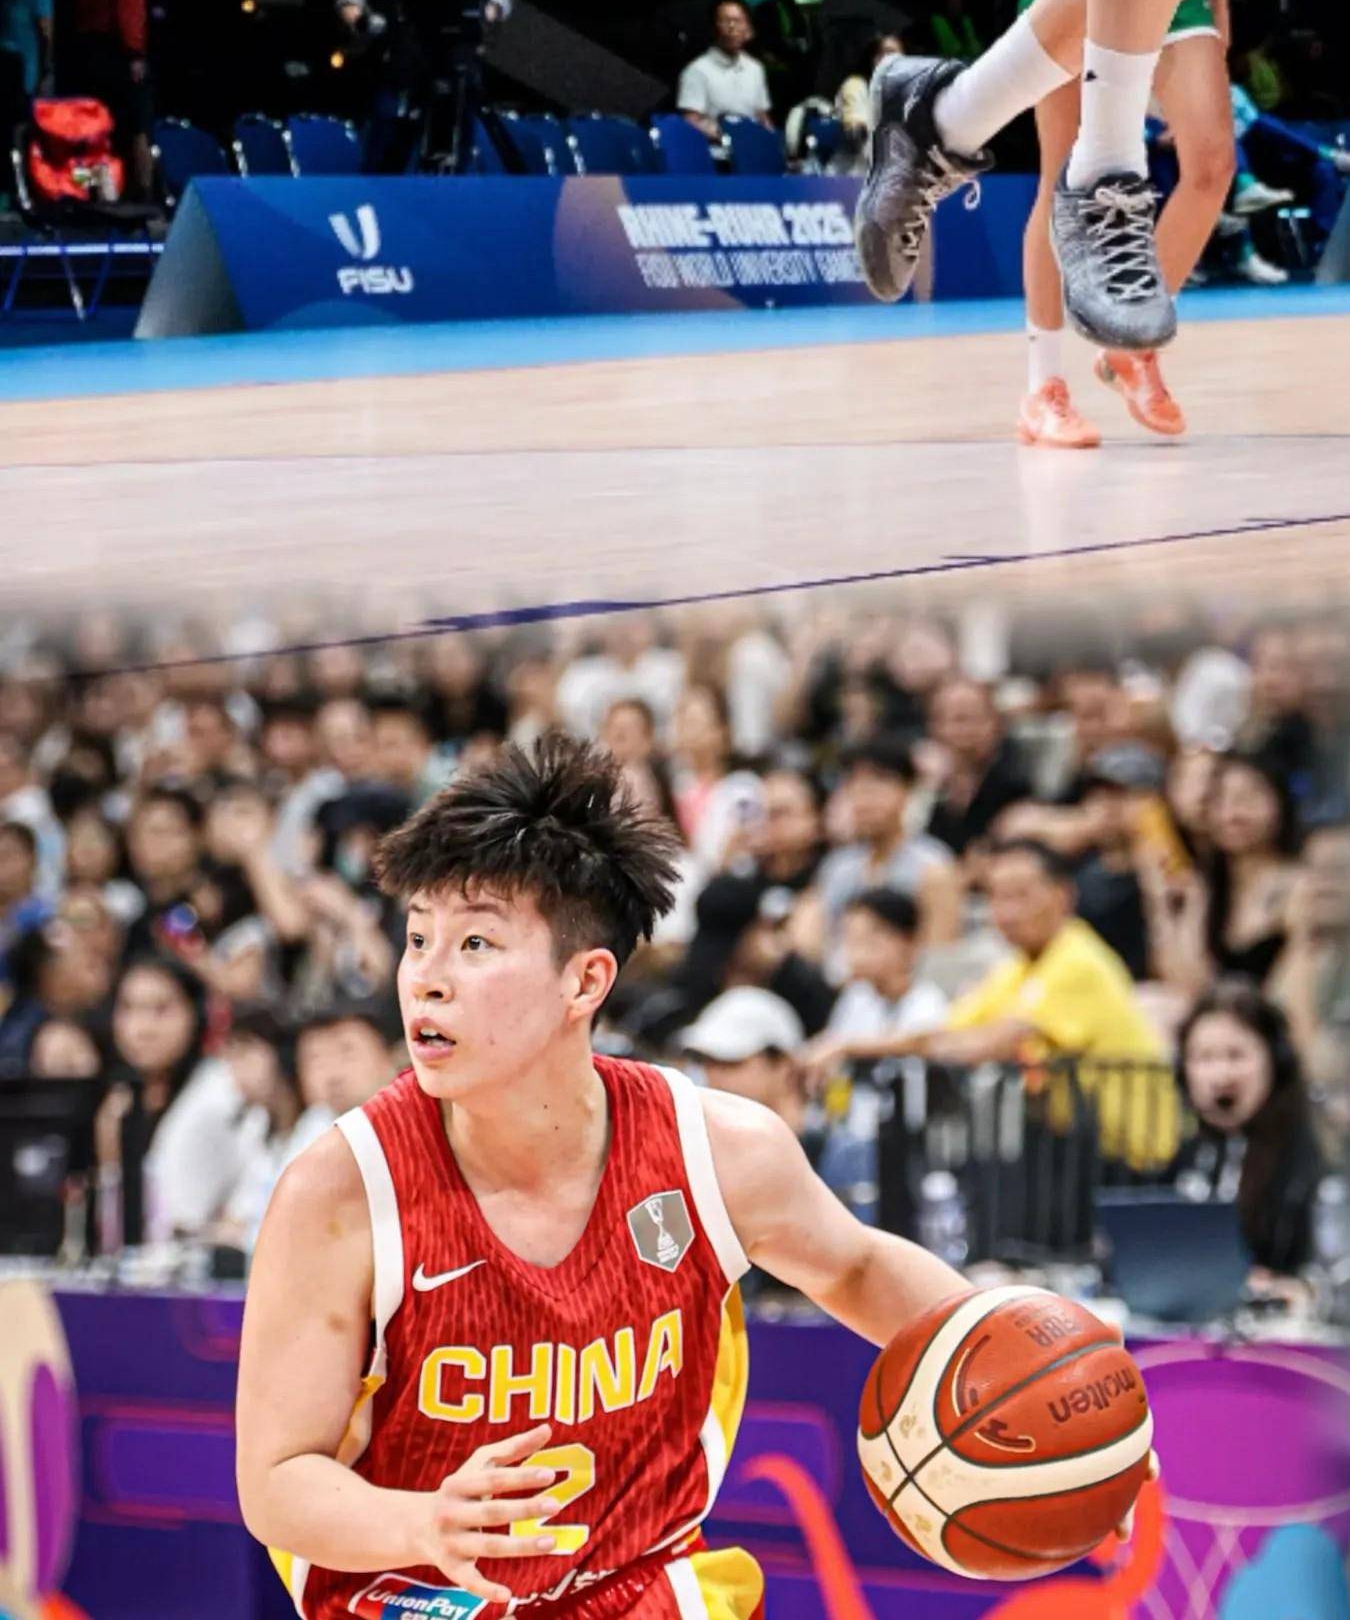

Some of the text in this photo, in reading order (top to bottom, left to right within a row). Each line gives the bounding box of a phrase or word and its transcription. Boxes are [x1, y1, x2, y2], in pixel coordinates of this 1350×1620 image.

[337, 266, 414, 294] FISU
[419, 1309, 682, 1425] CHINA
[1047, 1366, 1137, 1423] molten
[366, 1588, 470, 1620] UnionPay
